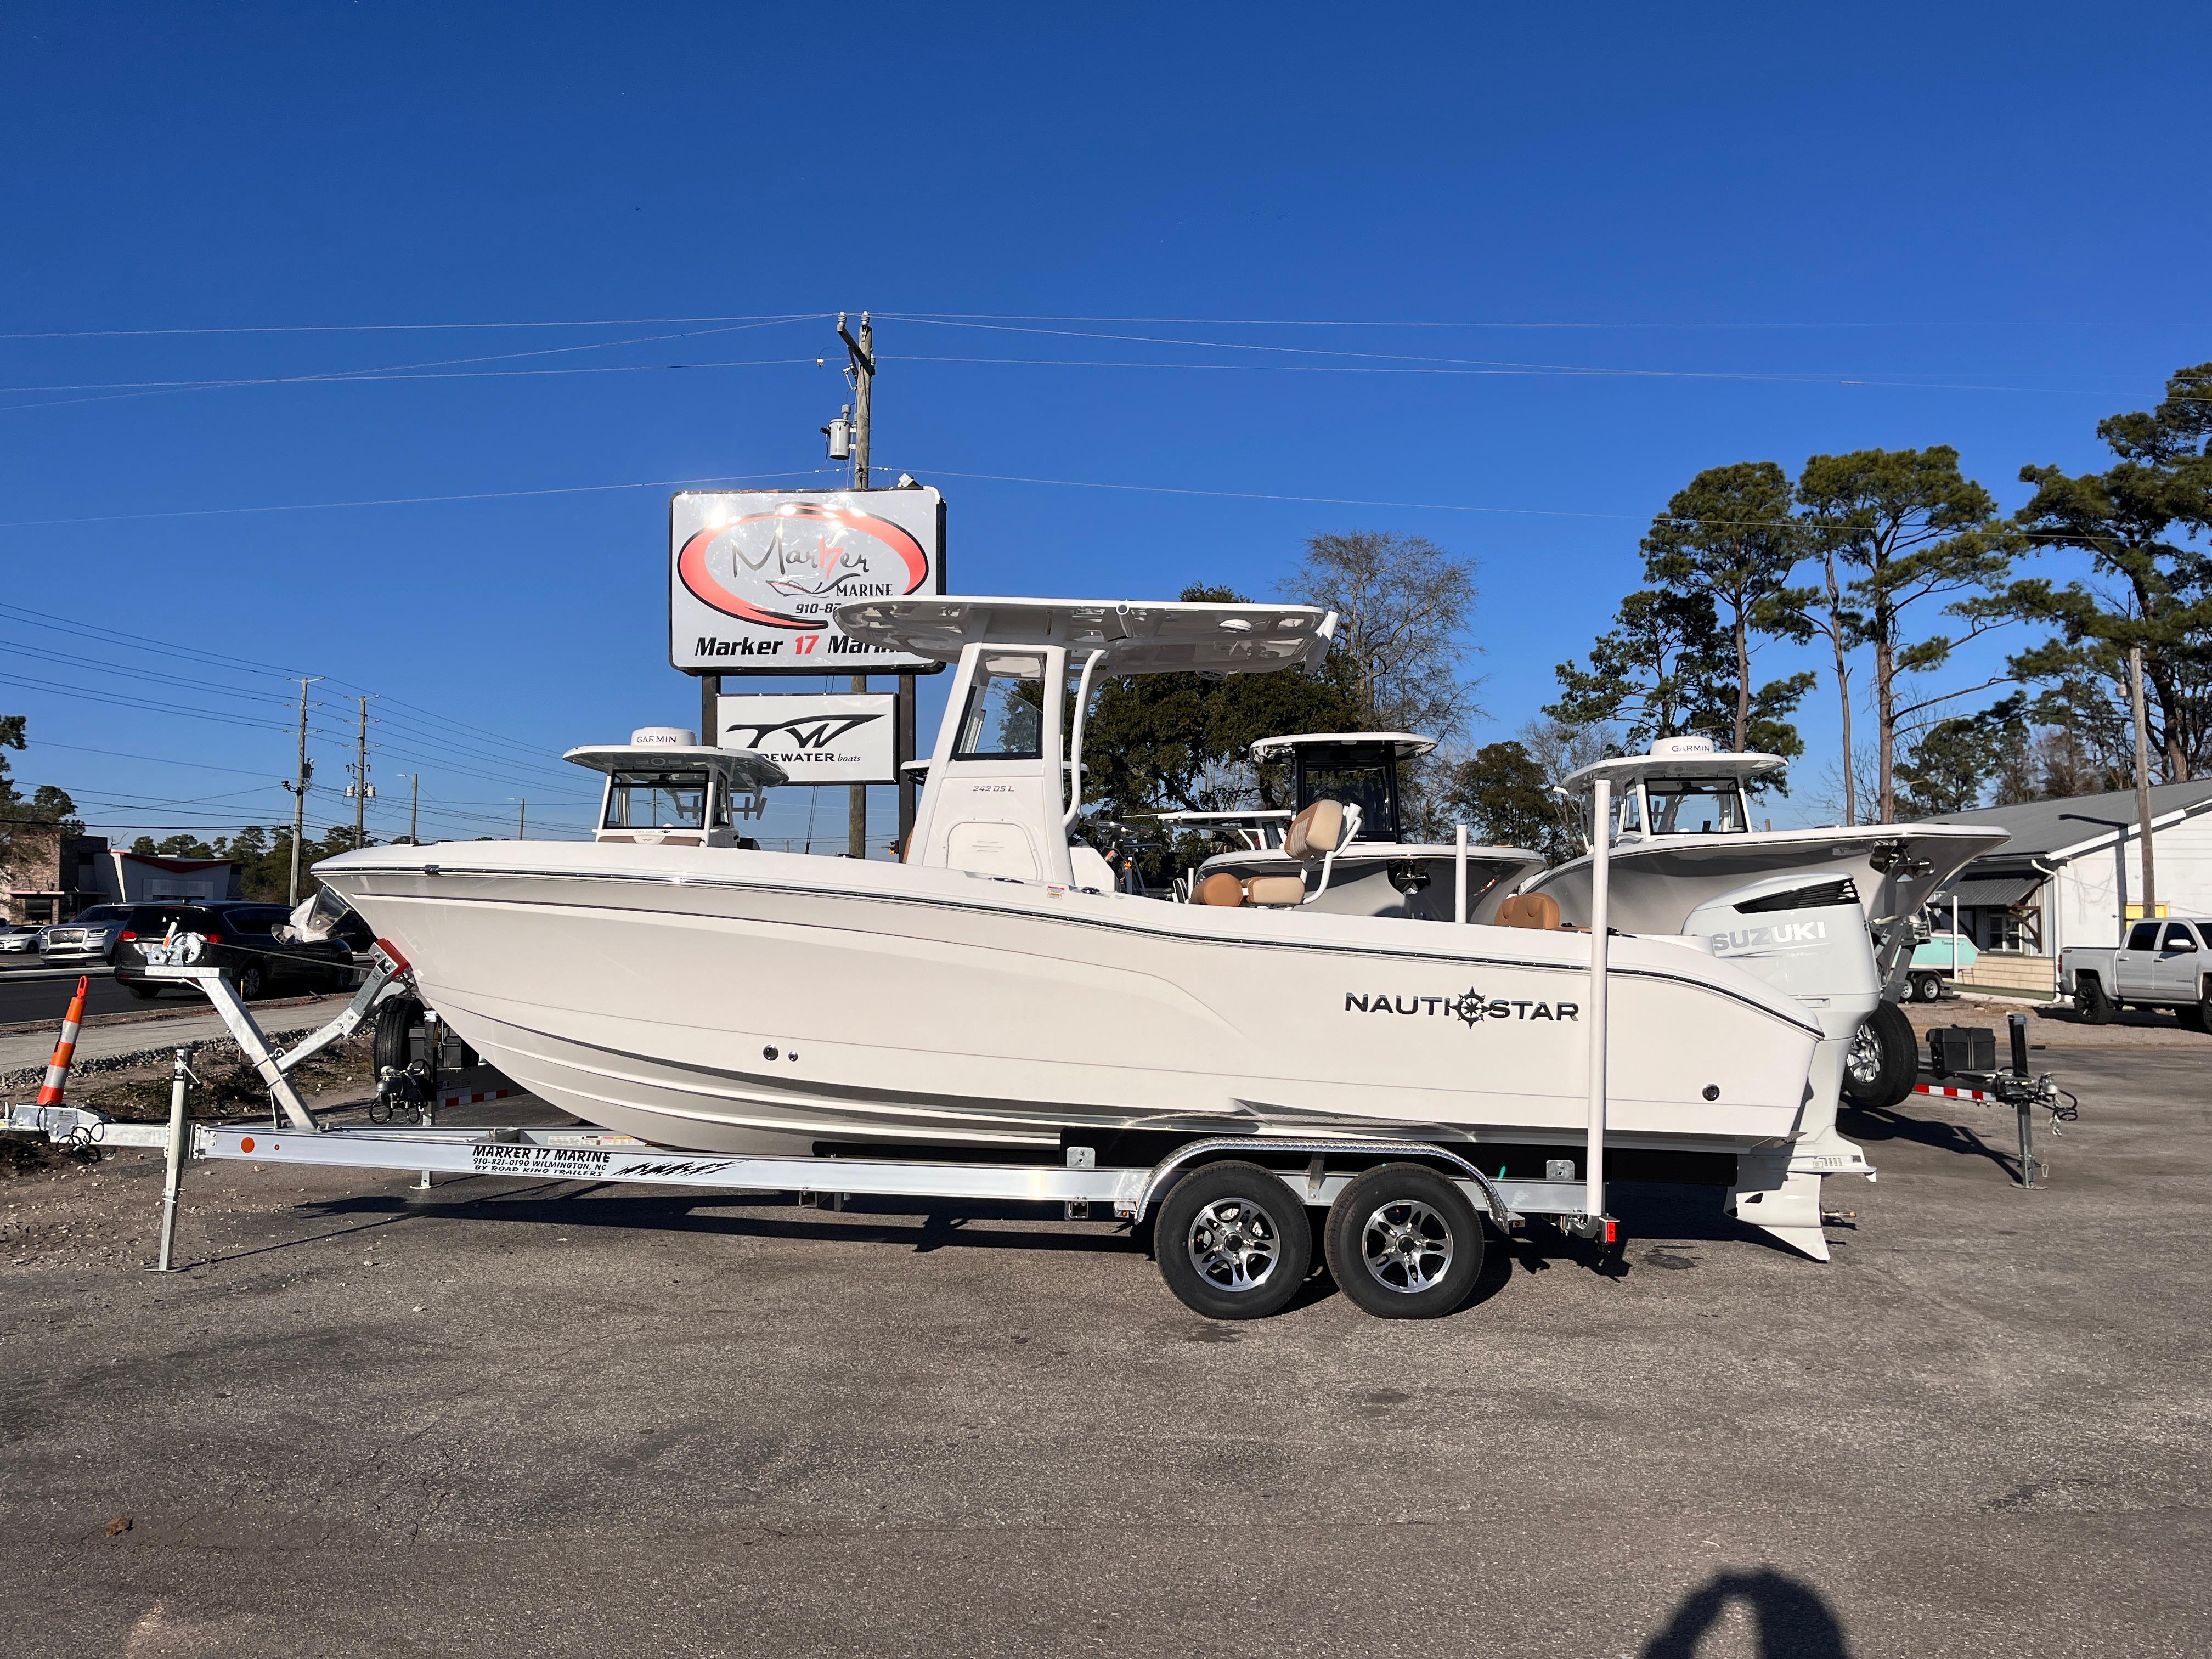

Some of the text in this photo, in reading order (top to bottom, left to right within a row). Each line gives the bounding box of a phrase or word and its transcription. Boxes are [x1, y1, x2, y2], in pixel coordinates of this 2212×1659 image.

[836, 584, 893, 596] MARINE
[695, 637, 783, 656] Marker
[795, 635, 819, 654] 17
[837, 753, 861, 762] boats
[1712, 921, 1826, 951] SUZUKI
[472, 1146, 611, 1163] MARKER 17 MARINE
[473, 1158, 529, 1166] 910-821-0190
